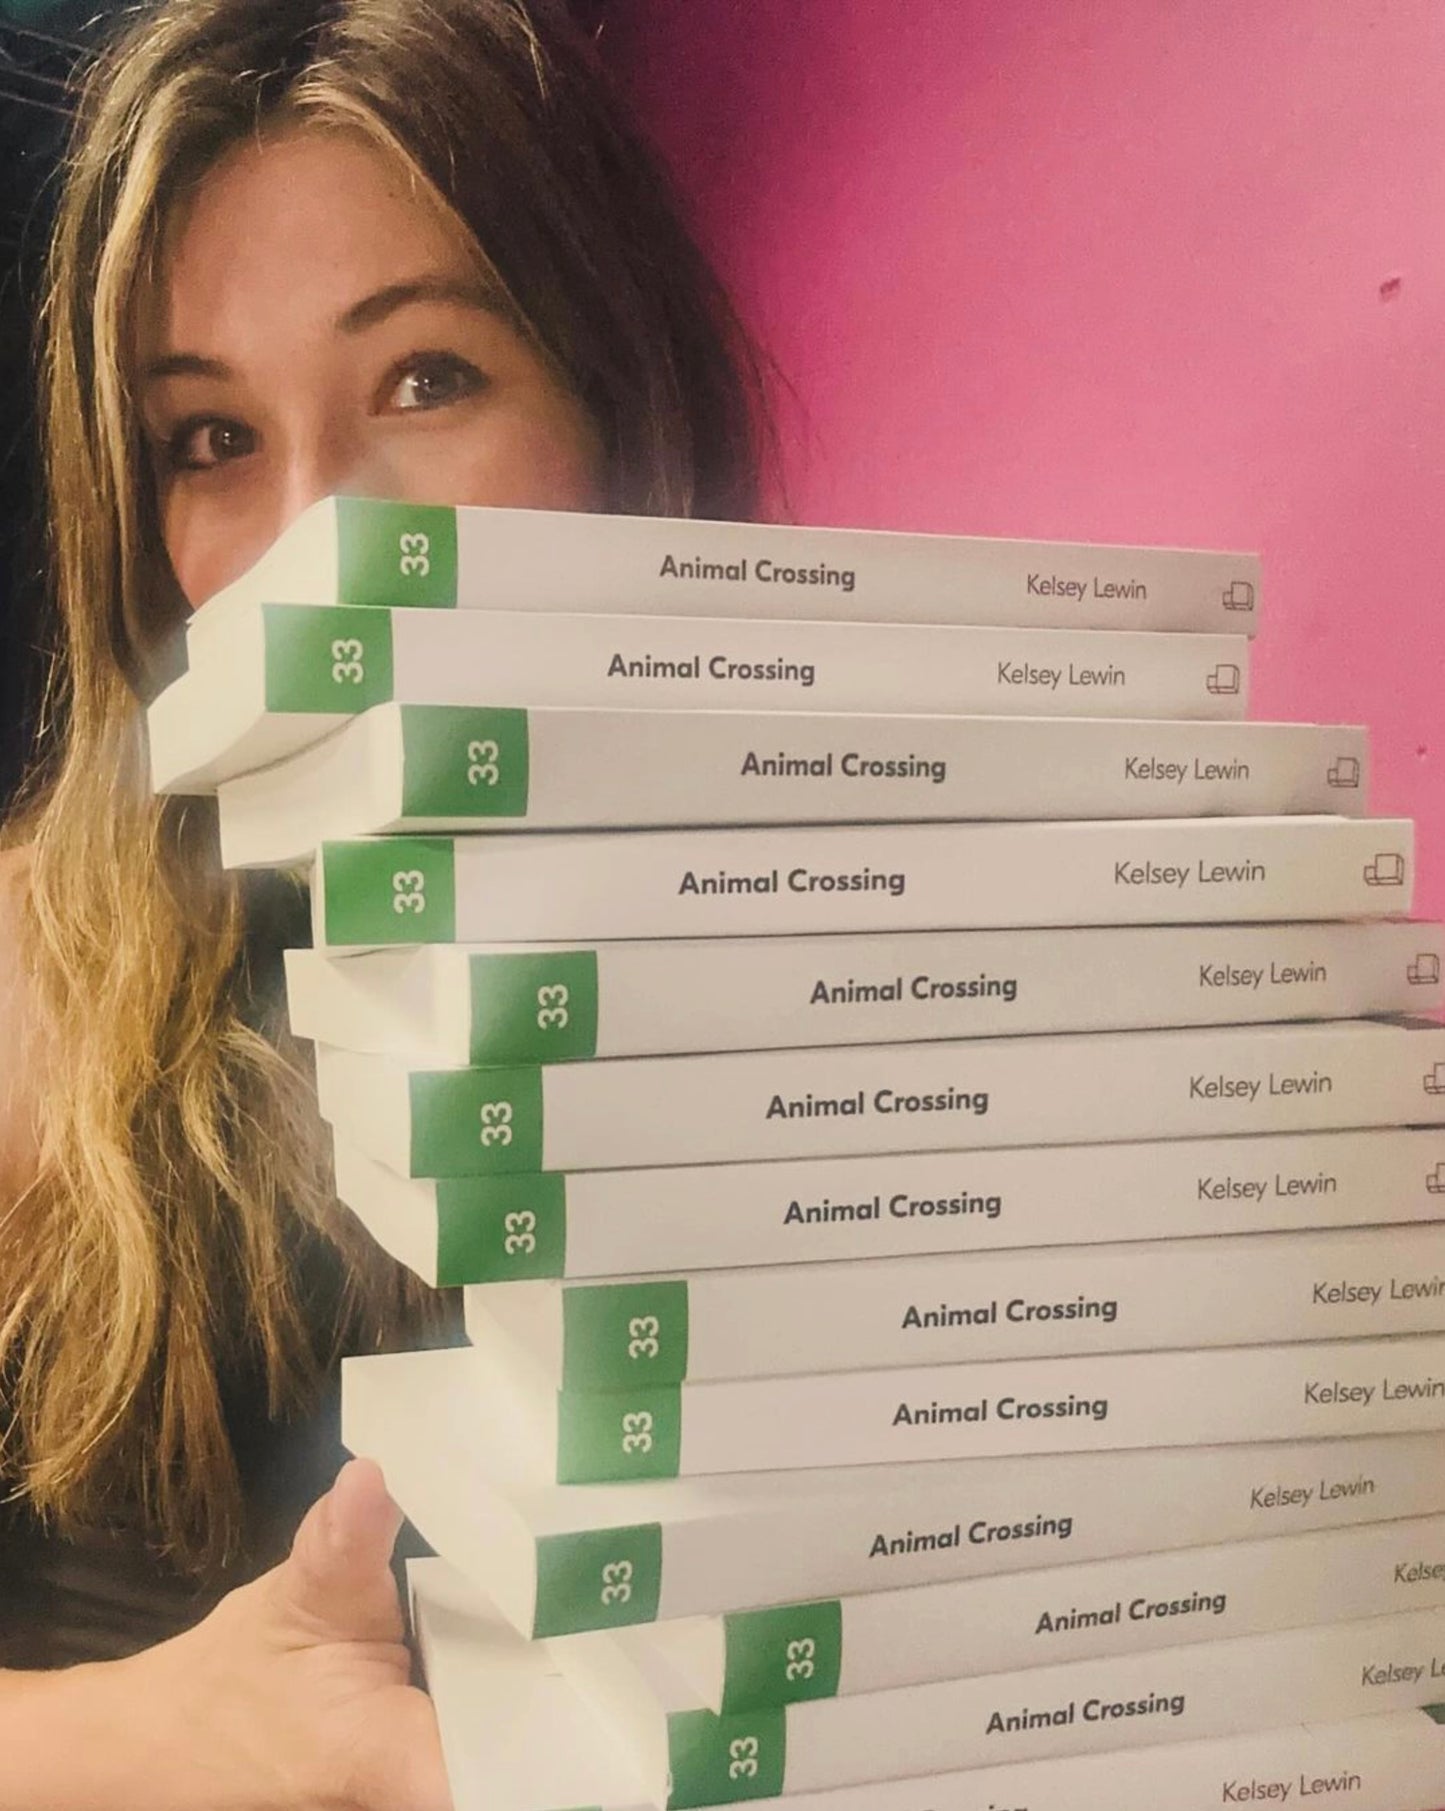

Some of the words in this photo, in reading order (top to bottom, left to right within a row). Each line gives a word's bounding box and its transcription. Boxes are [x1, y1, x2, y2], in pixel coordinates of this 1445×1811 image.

[399, 532, 430, 577] 33
[659, 554, 747, 582] Animal
[754, 559, 856, 593] Crossing
[1027, 573, 1088, 603] Kelsey
[1093, 576, 1147, 600] Lewin
[331, 638, 364, 684] 33
[607, 653, 700, 679] Animal
[708, 655, 815, 688] Crossing
[997, 661, 1063, 691] Kelsey
[1068, 663, 1126, 686] Lewin
[467, 740, 500, 786] 33
[740, 751, 833, 777] Animal
[840, 752, 947, 785] Crossing
[1124, 756, 1189, 785] Kelsey
[1193, 757, 1250, 781] Lewin
[392, 869, 426, 914] 33
[678, 869, 779, 896] Animal
[787, 867, 906, 897] Crossing
[1114, 860, 1191, 889] Kelsey
[1198, 859, 1266, 883] Lewin
[809, 976, 903, 1005] Animal
[910, 973, 1018, 1003] Crossing
[1199, 963, 1265, 990] Kelsey
[1270, 960, 1327, 985] Lewin
[537, 983, 569, 1030] 33
[765, 1090, 865, 1120] Animal
[873, 1086, 989, 1116] Crossing
[1189, 1074, 1262, 1103] Kelsey
[1269, 1070, 1333, 1096] Lewin
[480, 1101, 513, 1147] 33
[1197, 1176, 1268, 1203] Kelsey
[1275, 1171, 1337, 1197] Lewin
[783, 1195, 880, 1225] Animal
[888, 1191, 1002, 1219] Crossing
[504, 1210, 536, 1255] 33
[1312, 1280, 1383, 1307] Kelsey
[901, 1300, 997, 1330] Animal
[1005, 1295, 1118, 1323] Crossing
[628, 1315, 660, 1359] 33
[1304, 1380, 1376, 1407] Kelsey
[1382, 1377, 1445, 1401] Lewin
[892, 1398, 988, 1427] Animal
[996, 1394, 1108, 1421] Crossing
[622, 1411, 653, 1454] 33
[1249, 1485, 1314, 1510] Kelsey
[1319, 1475, 1375, 1501] Lewin
[868, 1524, 961, 1558] Animal
[968, 1514, 1073, 1545] Crossing
[600, 1560, 633, 1605] 33
[1394, 1561, 1445, 1584] Kelse
[1034, 1601, 1122, 1635] Animal
[1128, 1591, 1227, 1621] Crossing
[785, 1637, 816, 1682] 33
[1361, 1662, 1425, 1687] Kelsey
[985, 1701, 1075, 1735] Animal
[1082, 1692, 1185, 1722] Crossing
[728, 1735, 759, 1780] 33
[1222, 1779, 1293, 1803] Kelsey
[1299, 1770, 1361, 1797] Lewin
